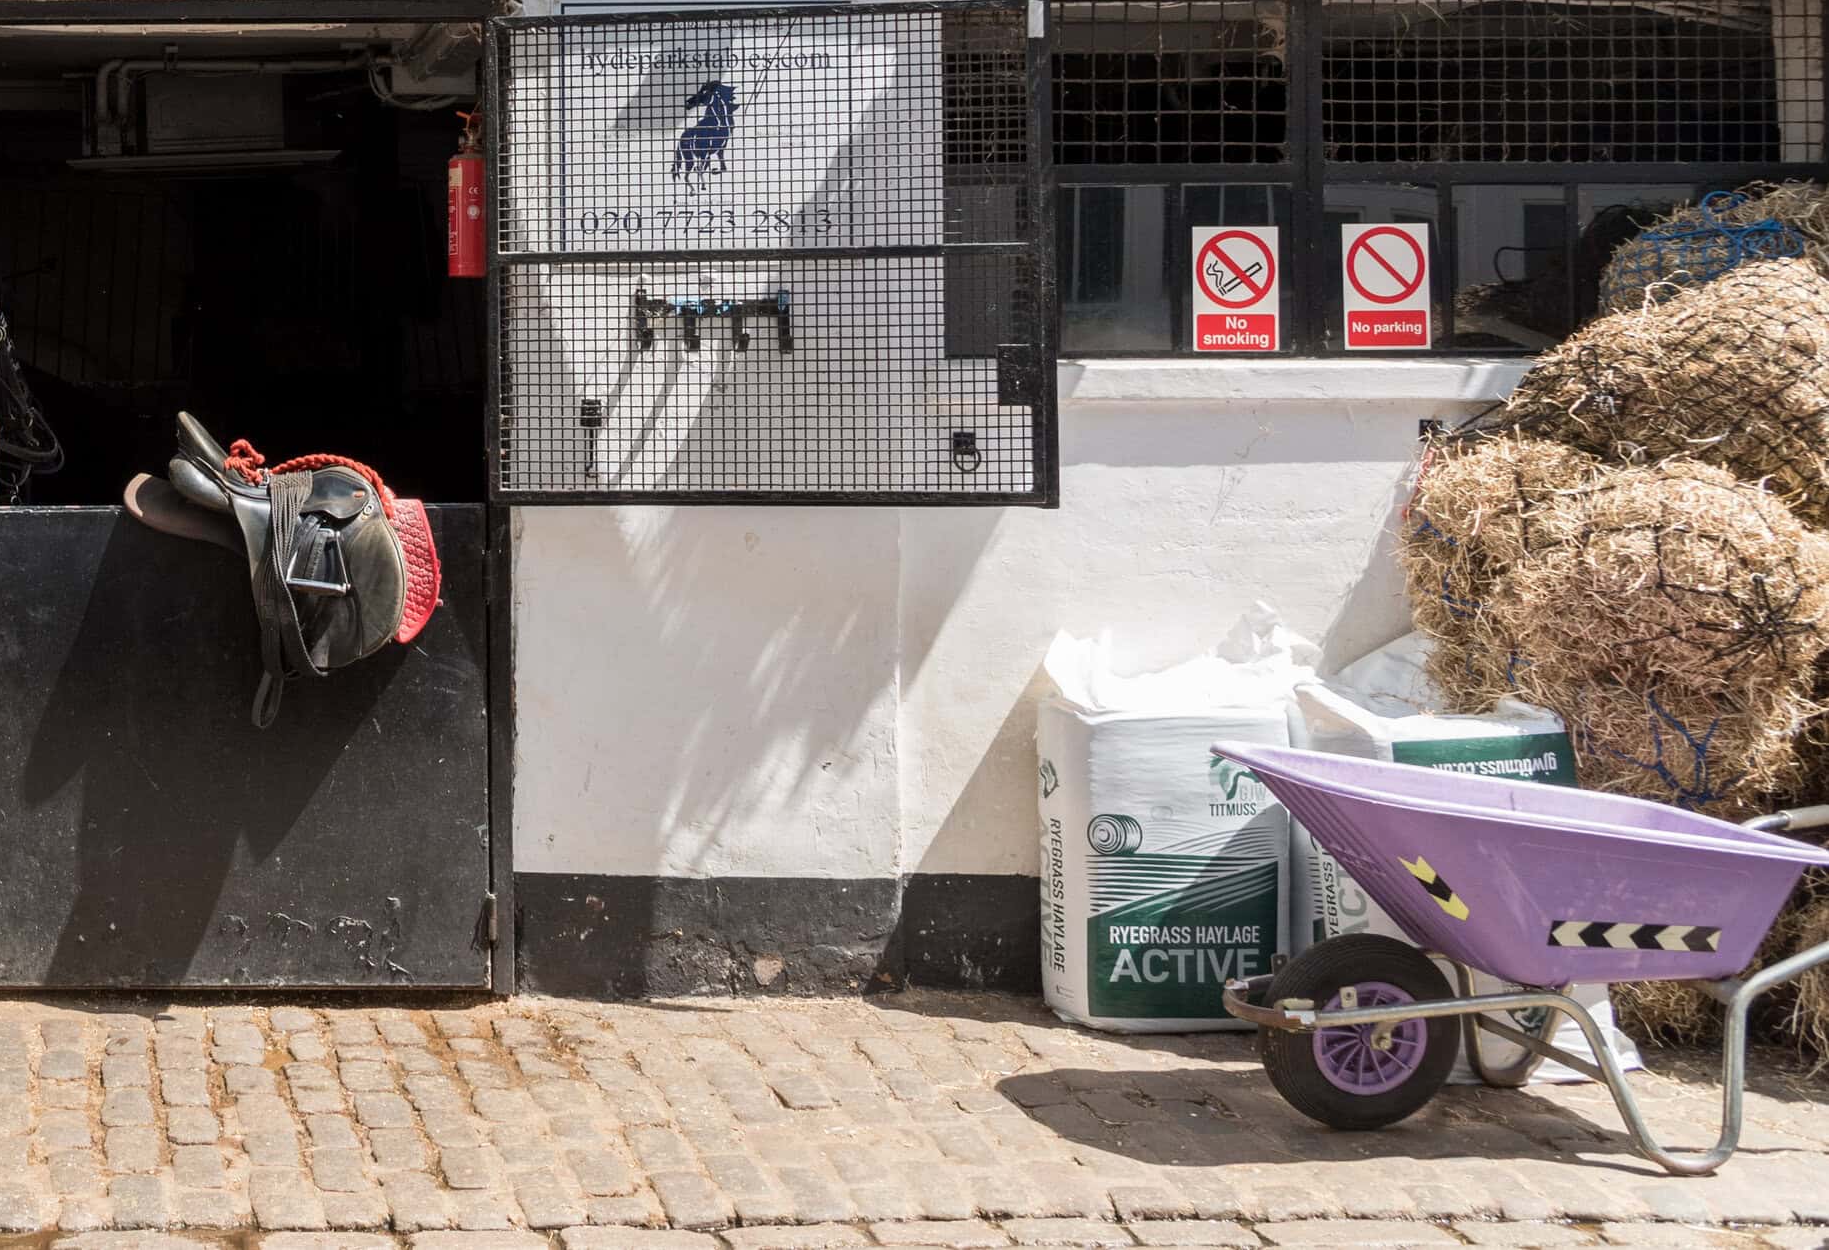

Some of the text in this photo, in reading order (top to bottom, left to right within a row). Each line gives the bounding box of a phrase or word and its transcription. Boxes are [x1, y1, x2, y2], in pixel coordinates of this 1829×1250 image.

[580, 210, 642, 235] 020
[655, 210, 736, 234] 7723
[1225, 316, 1248, 329] No
[1352, 321, 1423, 335] No parking
[1203, 331, 1270, 347] smoking
[1209, 802, 1258, 817] TITMUSS
[1050, 817, 1066, 974] RYEGRASS HAYLAGE
[1322, 861, 1341, 937] YEGRASS
[1109, 925, 1261, 944] RYEGRASS HAYLAGE
[1109, 948, 1261, 983] ACTIVE
